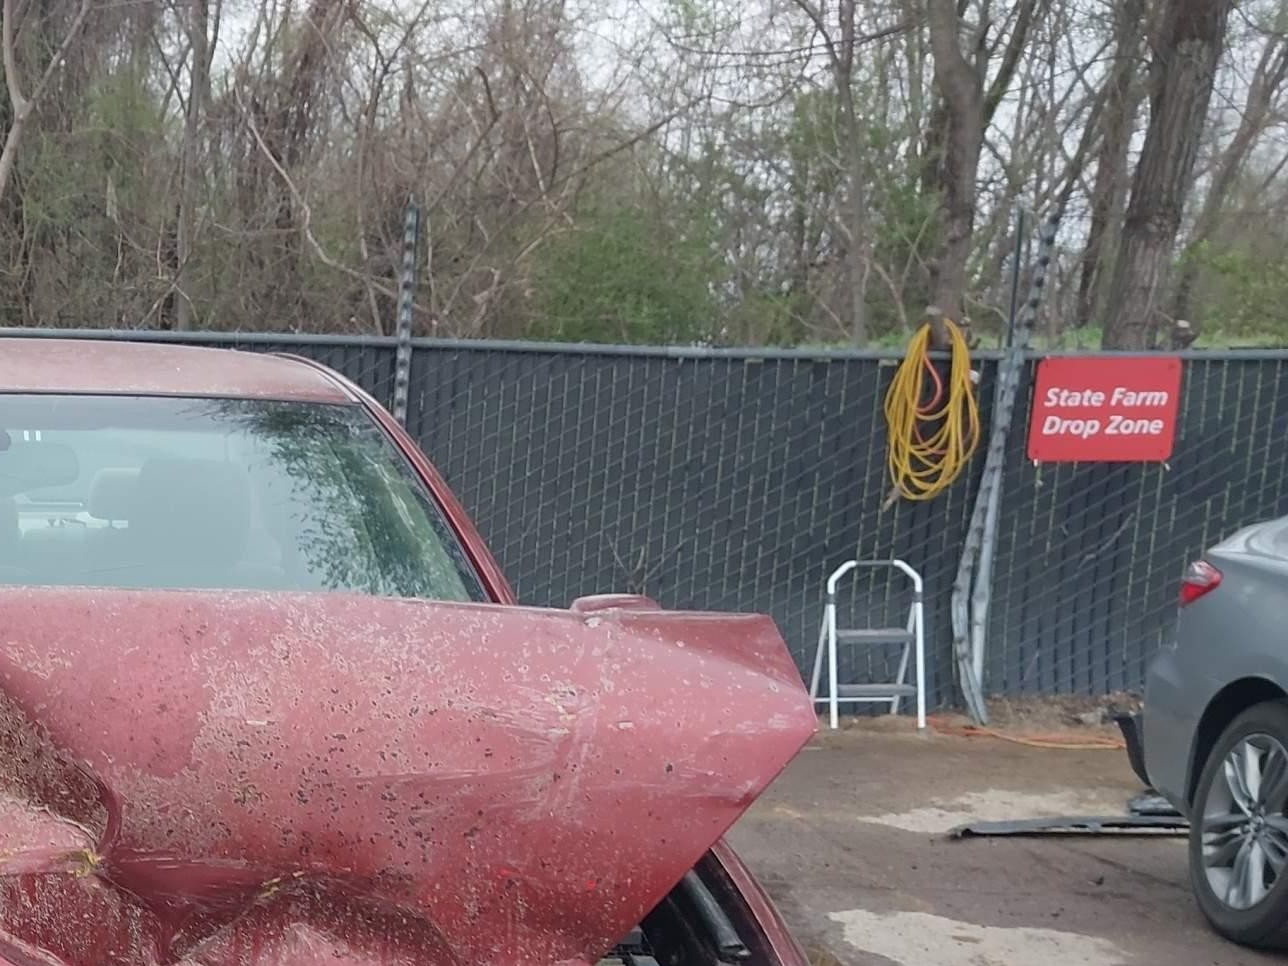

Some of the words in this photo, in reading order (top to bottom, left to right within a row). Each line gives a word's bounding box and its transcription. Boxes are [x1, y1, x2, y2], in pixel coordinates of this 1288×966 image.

[1043, 387, 1105, 407] State
[1110, 387, 1169, 407] Farm
[1042, 415, 1100, 439] Drop
[1104, 415, 1164, 435] Zone
